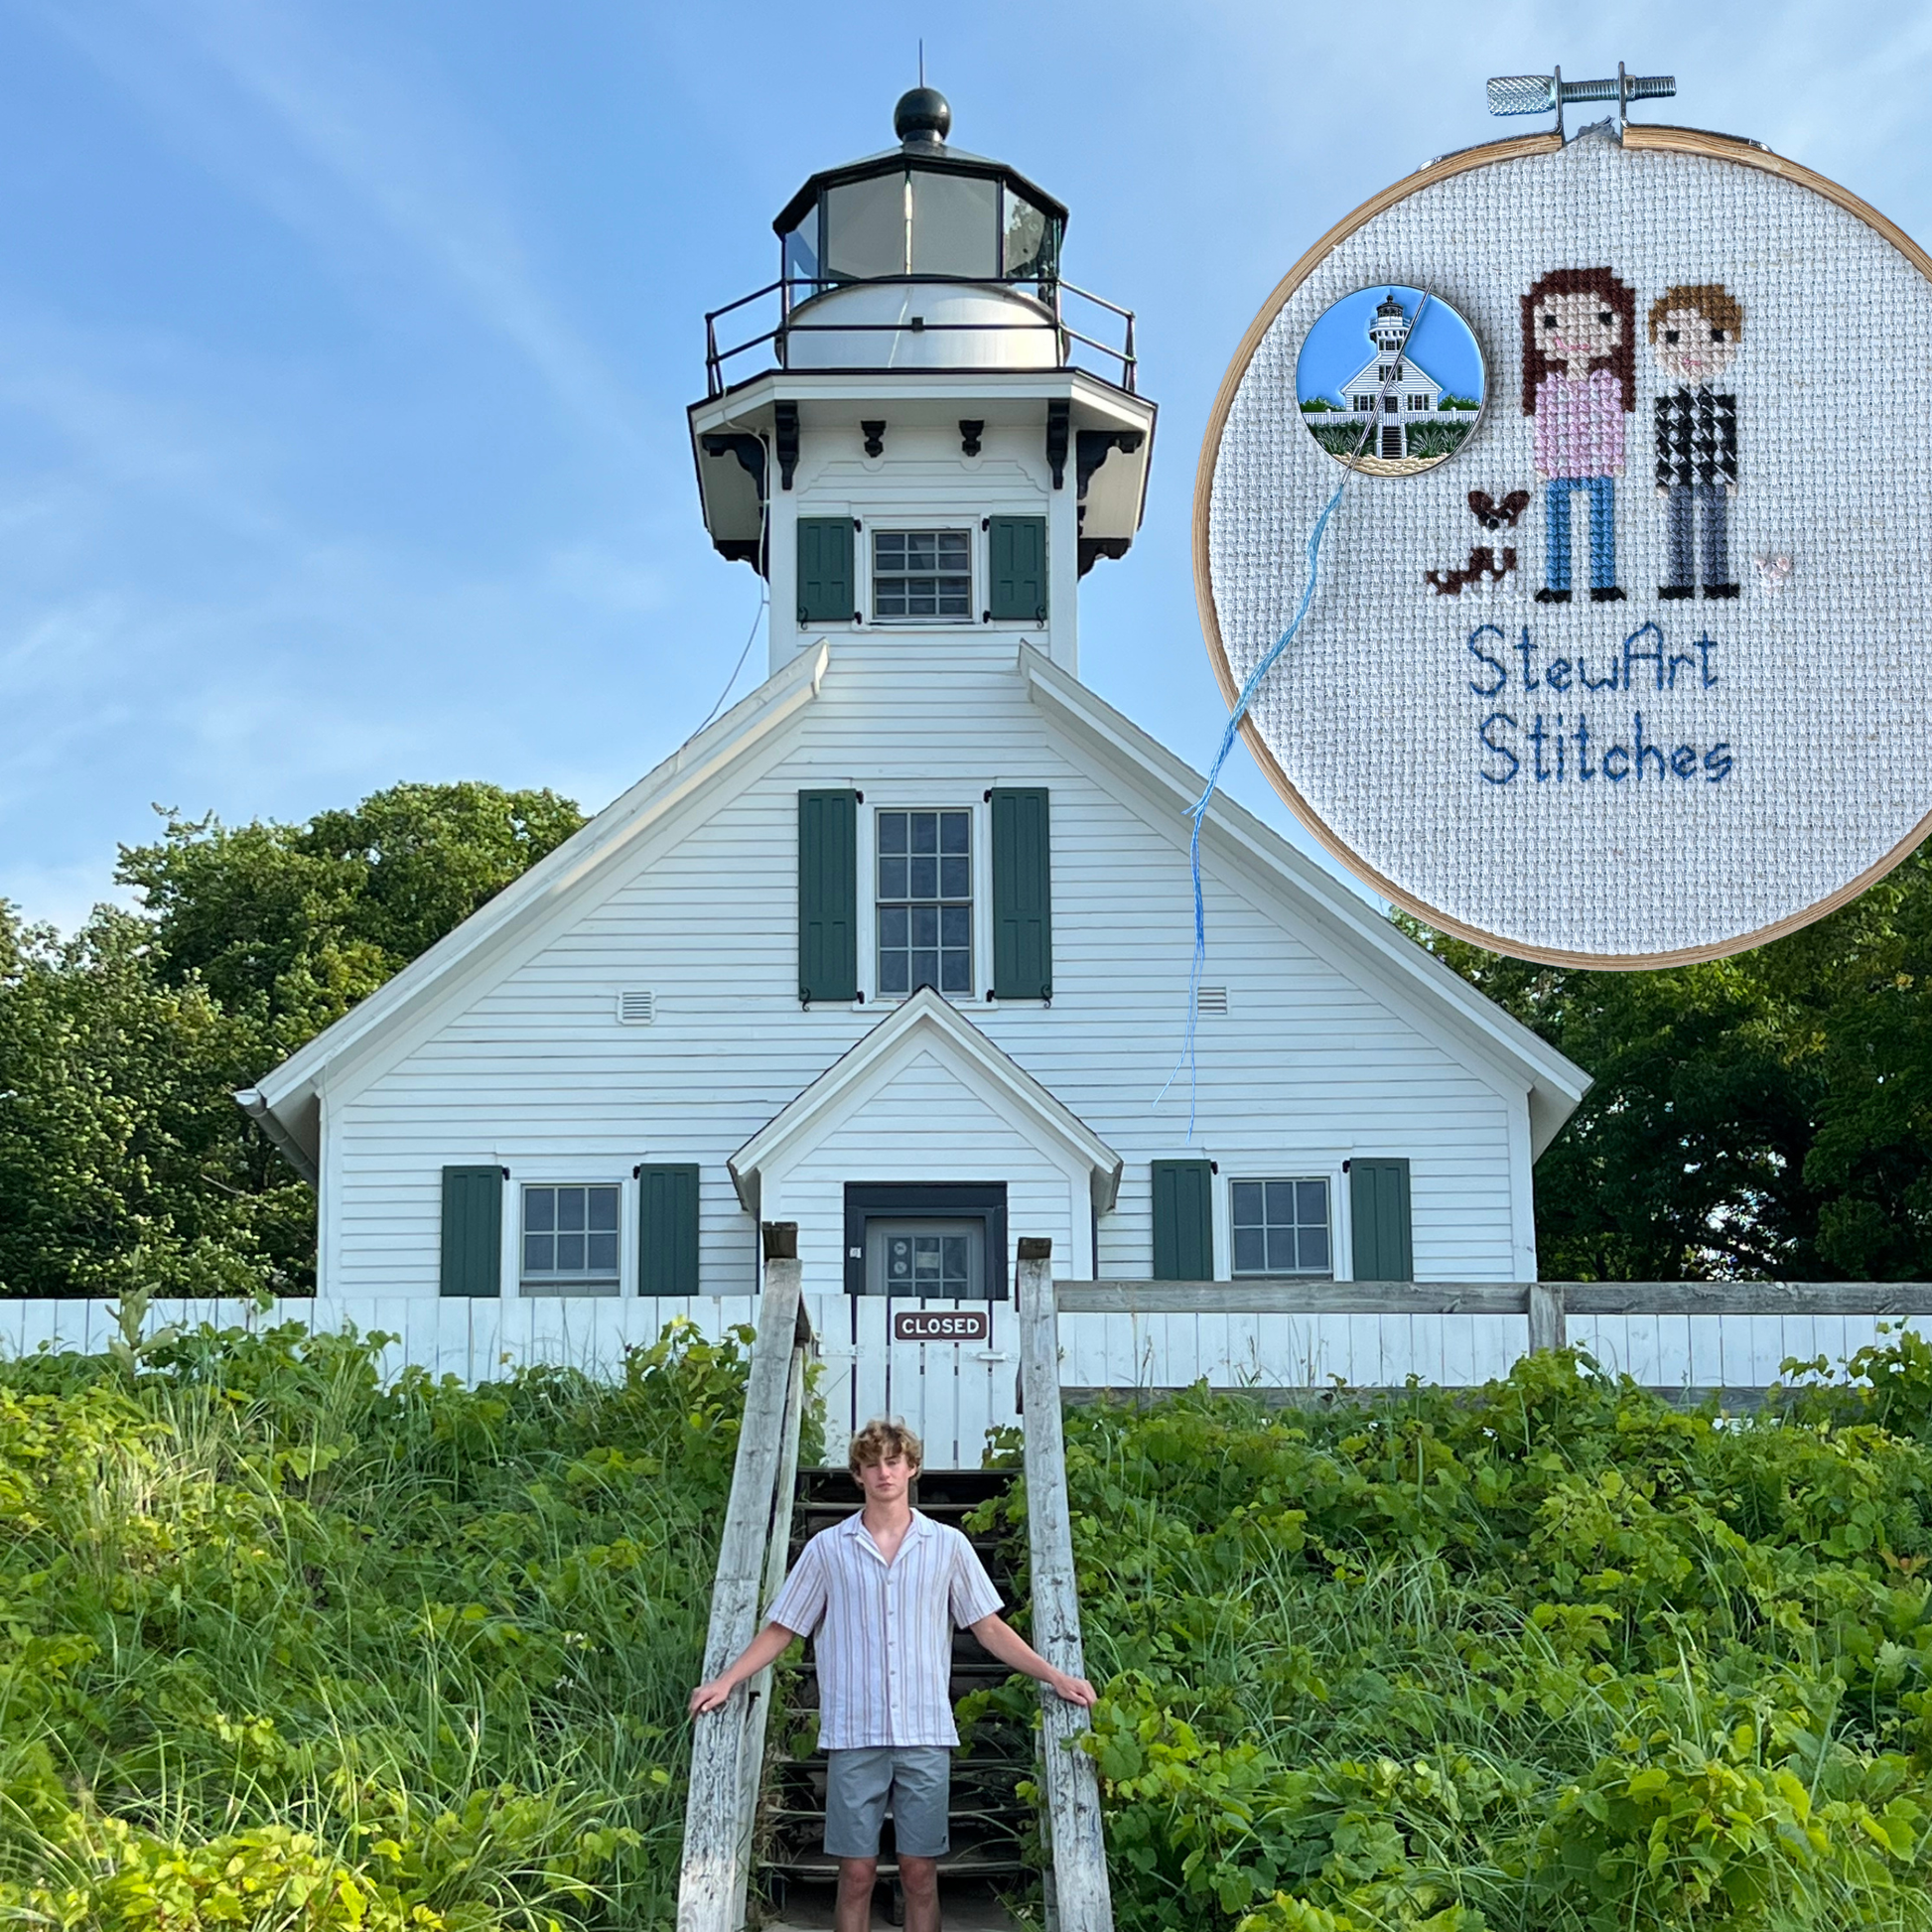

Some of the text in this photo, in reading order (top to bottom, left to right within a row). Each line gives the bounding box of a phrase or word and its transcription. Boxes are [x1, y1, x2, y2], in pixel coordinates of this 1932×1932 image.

[1468, 621, 1719, 696] StewArt
[1479, 710, 1733, 784] Stitches
[901, 1317, 980, 1334] CLOSED
